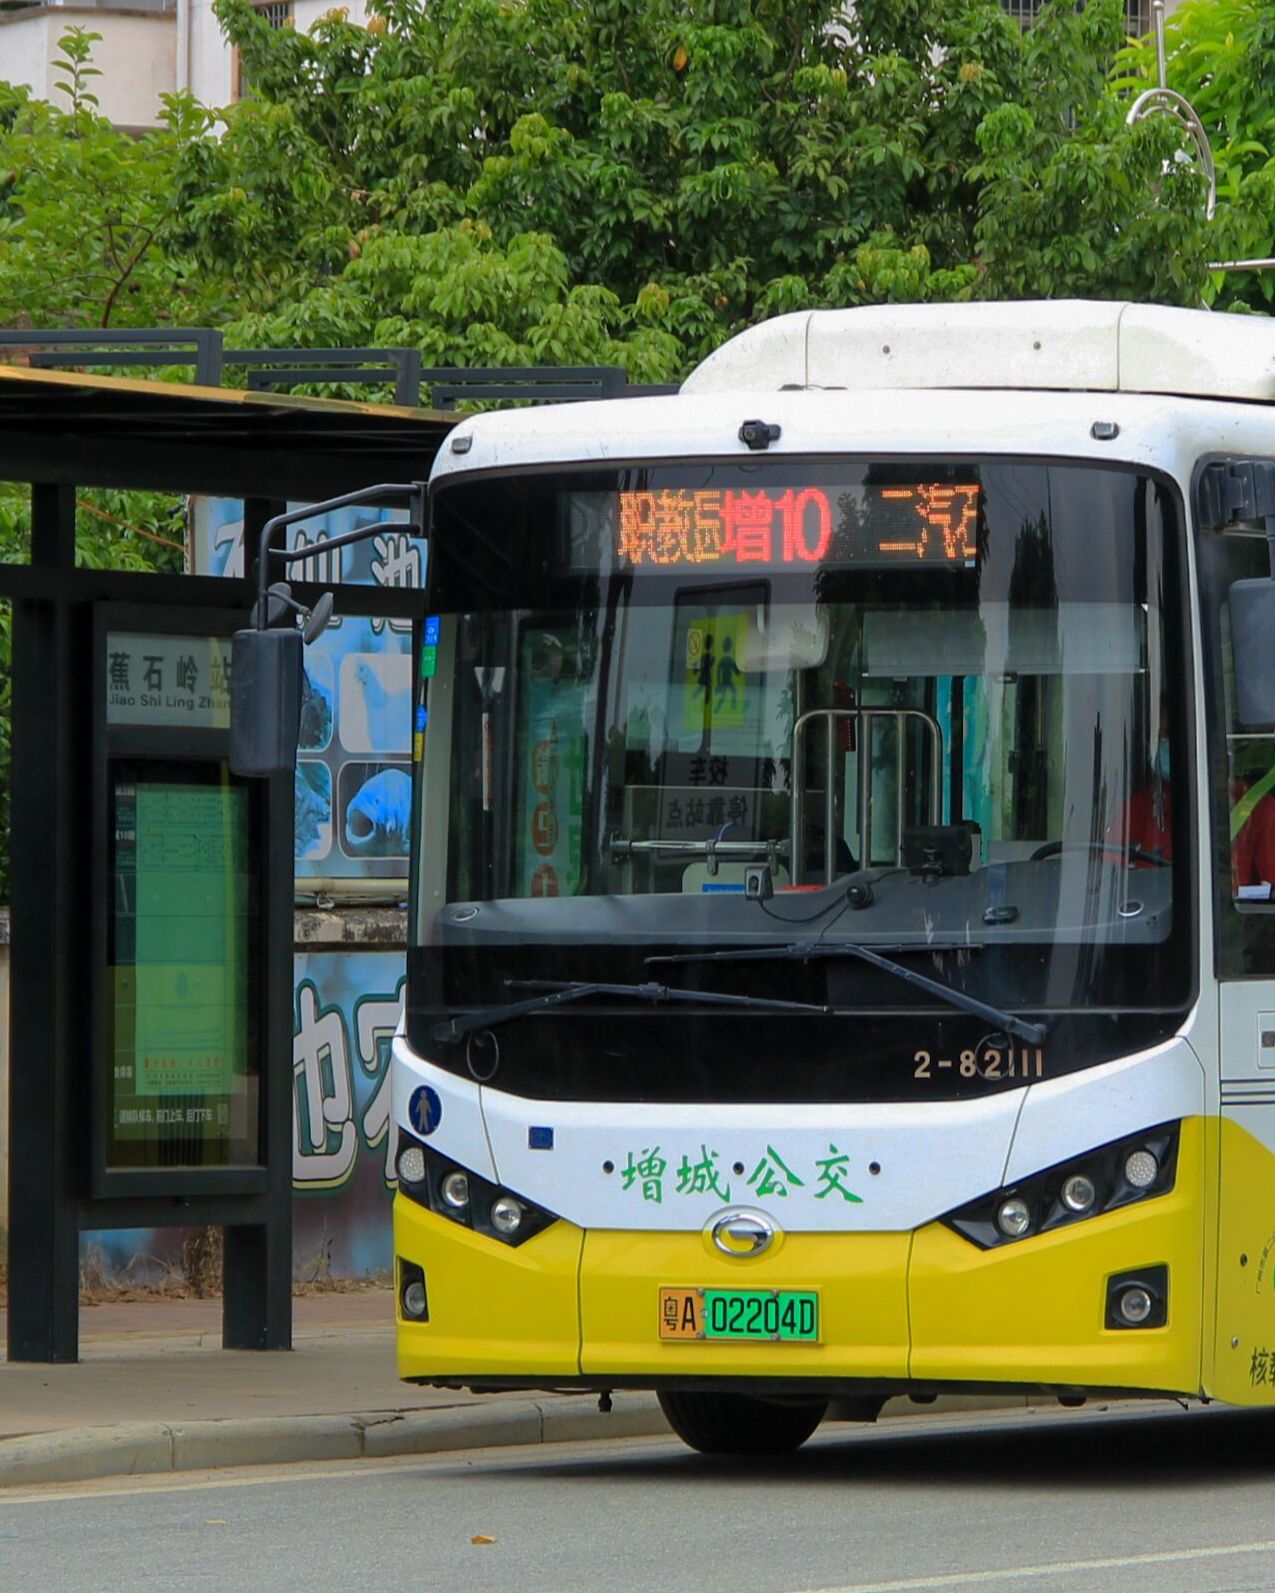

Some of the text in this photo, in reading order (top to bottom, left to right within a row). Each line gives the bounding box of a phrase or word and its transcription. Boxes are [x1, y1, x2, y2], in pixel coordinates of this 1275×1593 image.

[109, 694, 136, 707] Jiao
[140, 695, 162, 708] Shi
[166, 696, 194, 711] Ling
[914, 1049, 1043, 1079] 2-82111
[620, 1143, 864, 1204] 增城公交
